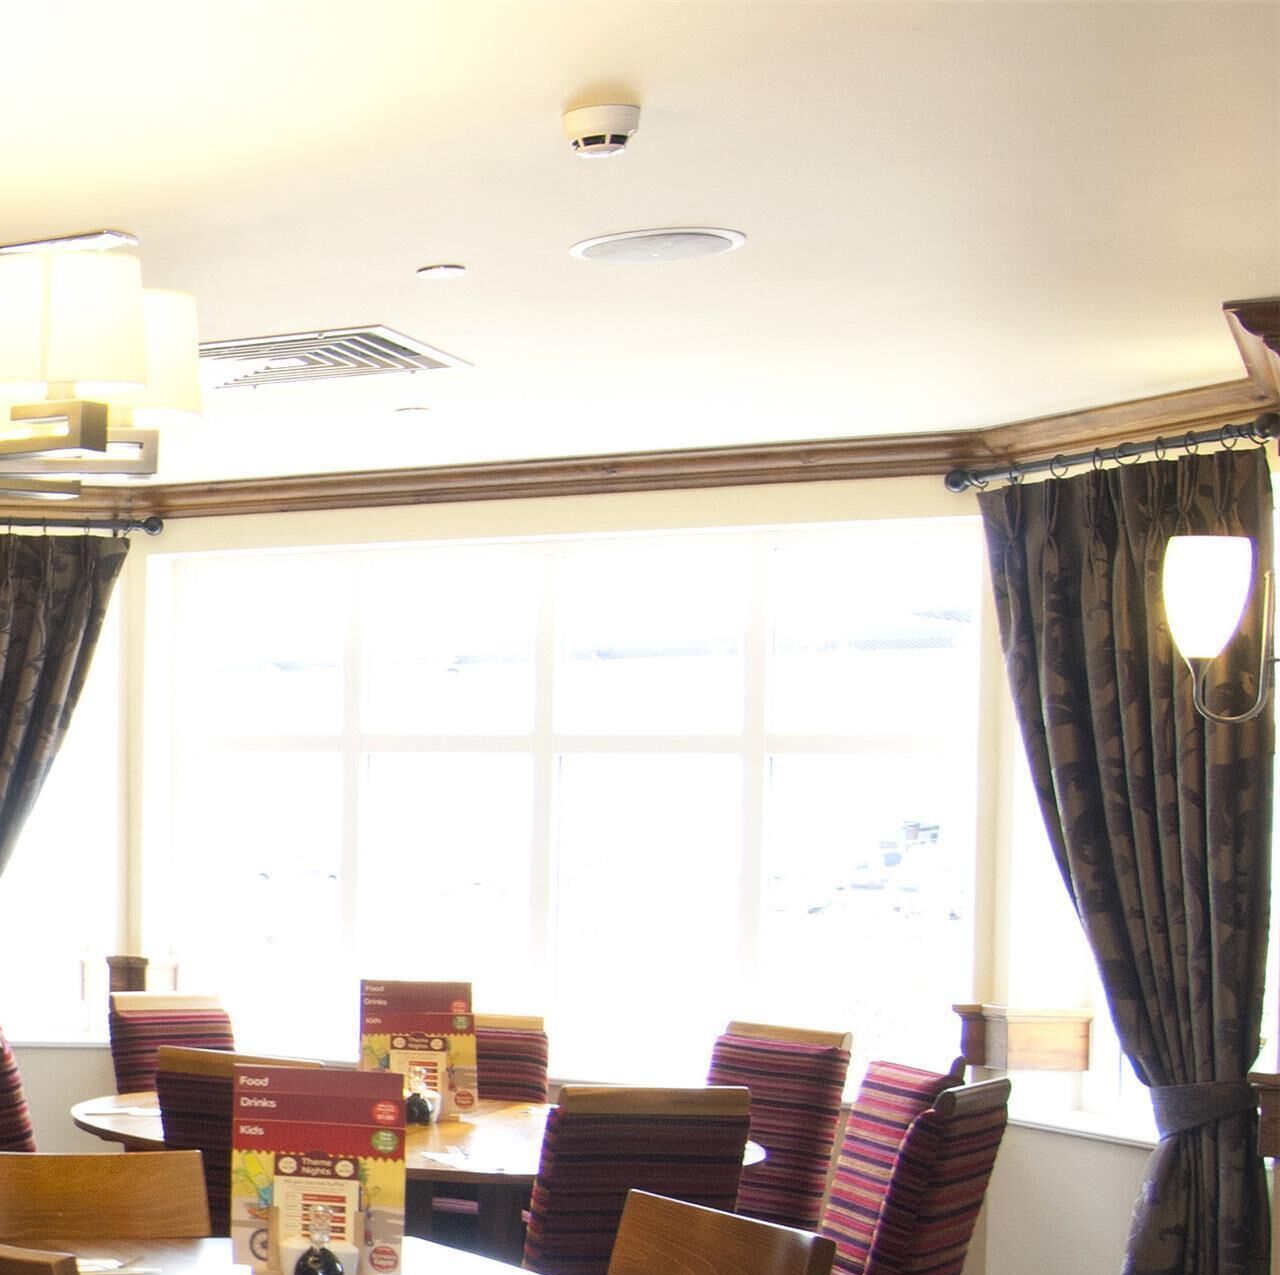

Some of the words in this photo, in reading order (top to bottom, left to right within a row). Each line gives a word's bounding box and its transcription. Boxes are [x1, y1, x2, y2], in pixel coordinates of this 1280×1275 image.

[239, 1076, 269, 1086] Food
[240, 1097, 277, 1108] Drinks
[239, 1125, 265, 1136] Kids
[301, 1157, 332, 1167] Theme
[302, 1166, 332, 1176] Nights
